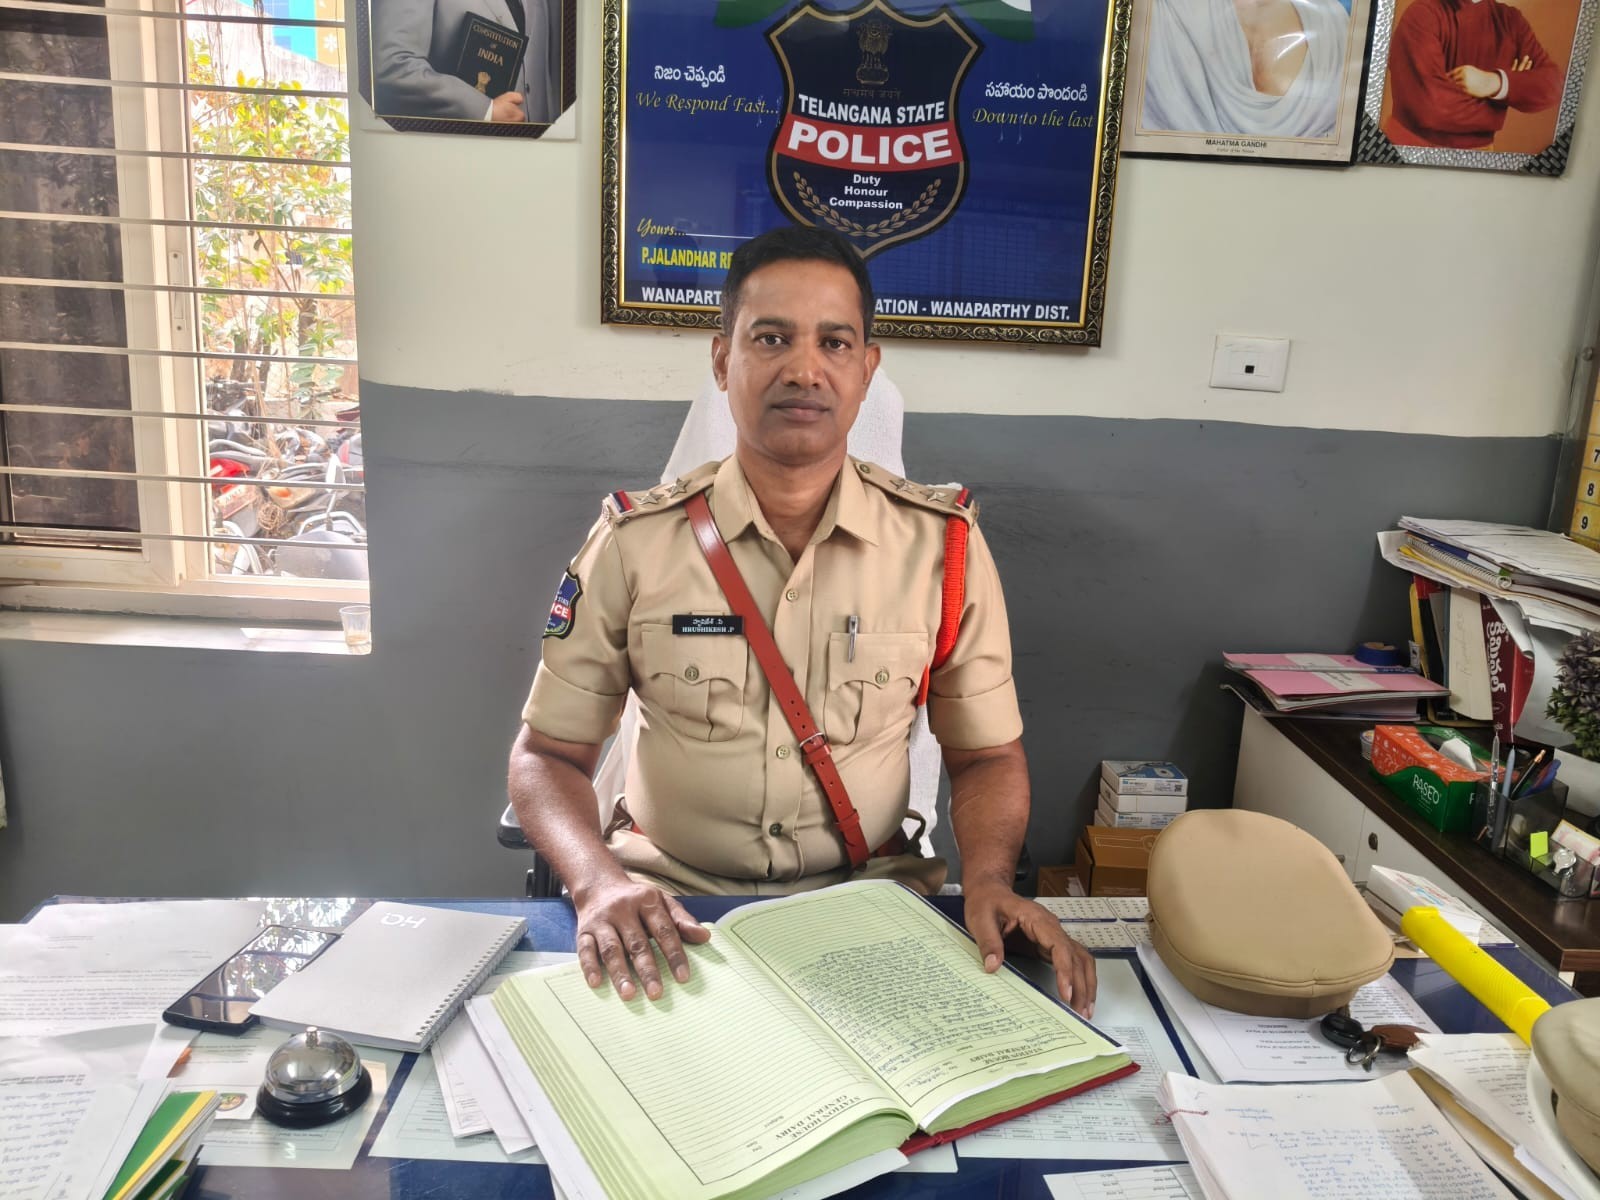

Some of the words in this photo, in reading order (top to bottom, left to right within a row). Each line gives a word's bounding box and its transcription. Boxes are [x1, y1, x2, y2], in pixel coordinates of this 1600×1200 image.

[473, 24, 519, 49] CONSTITUTION
[478, 47, 503, 67] INDIA
[654, 65, 681, 80] నిజం
[684, 65, 726, 88] చెప్పండి
[985, 81, 1035, 99] సహాయం
[1037, 83, 1088, 101] పొందండి
[636, 90, 661, 108] We
[665, 94, 732, 114] Respond
[799, 93, 892, 125] TELANGANA
[897, 101, 945, 124] STATE
[972, 108, 1021, 124] Down
[1022, 113, 1037, 125] to
[1041, 109, 1064, 127] the
[1067, 110, 1094, 128] last
[787, 120, 952, 165] POLICE
[1206, 139, 1239, 147] MAHATMA
[1240, 140, 1267, 149] GANDHI
[853, 174, 881, 186] Duty
[844, 186, 888, 197] Honour
[829, 197, 903, 210] Compassion
[641, 246, 717, 268] P.JALANDHAR
[930, 301, 1031, 319] WANAPARTHY
[1035, 304, 1070, 321] DIST.
[1587, 483, 1594, 497] 8
[1581, 516, 1588, 529] 9
[984, 1055, 1010, 1064] HOUSE
[996, 1045, 1031, 1055] GENERAL
[1010, 1047, 1043, 1058] STATION
[806, 1095, 848, 1121] GENERAL
[822, 1095, 861, 1119] STATION
[775, 1120, 805, 1140] DAIRY
[791, 1117, 822, 1139] HOUSE
